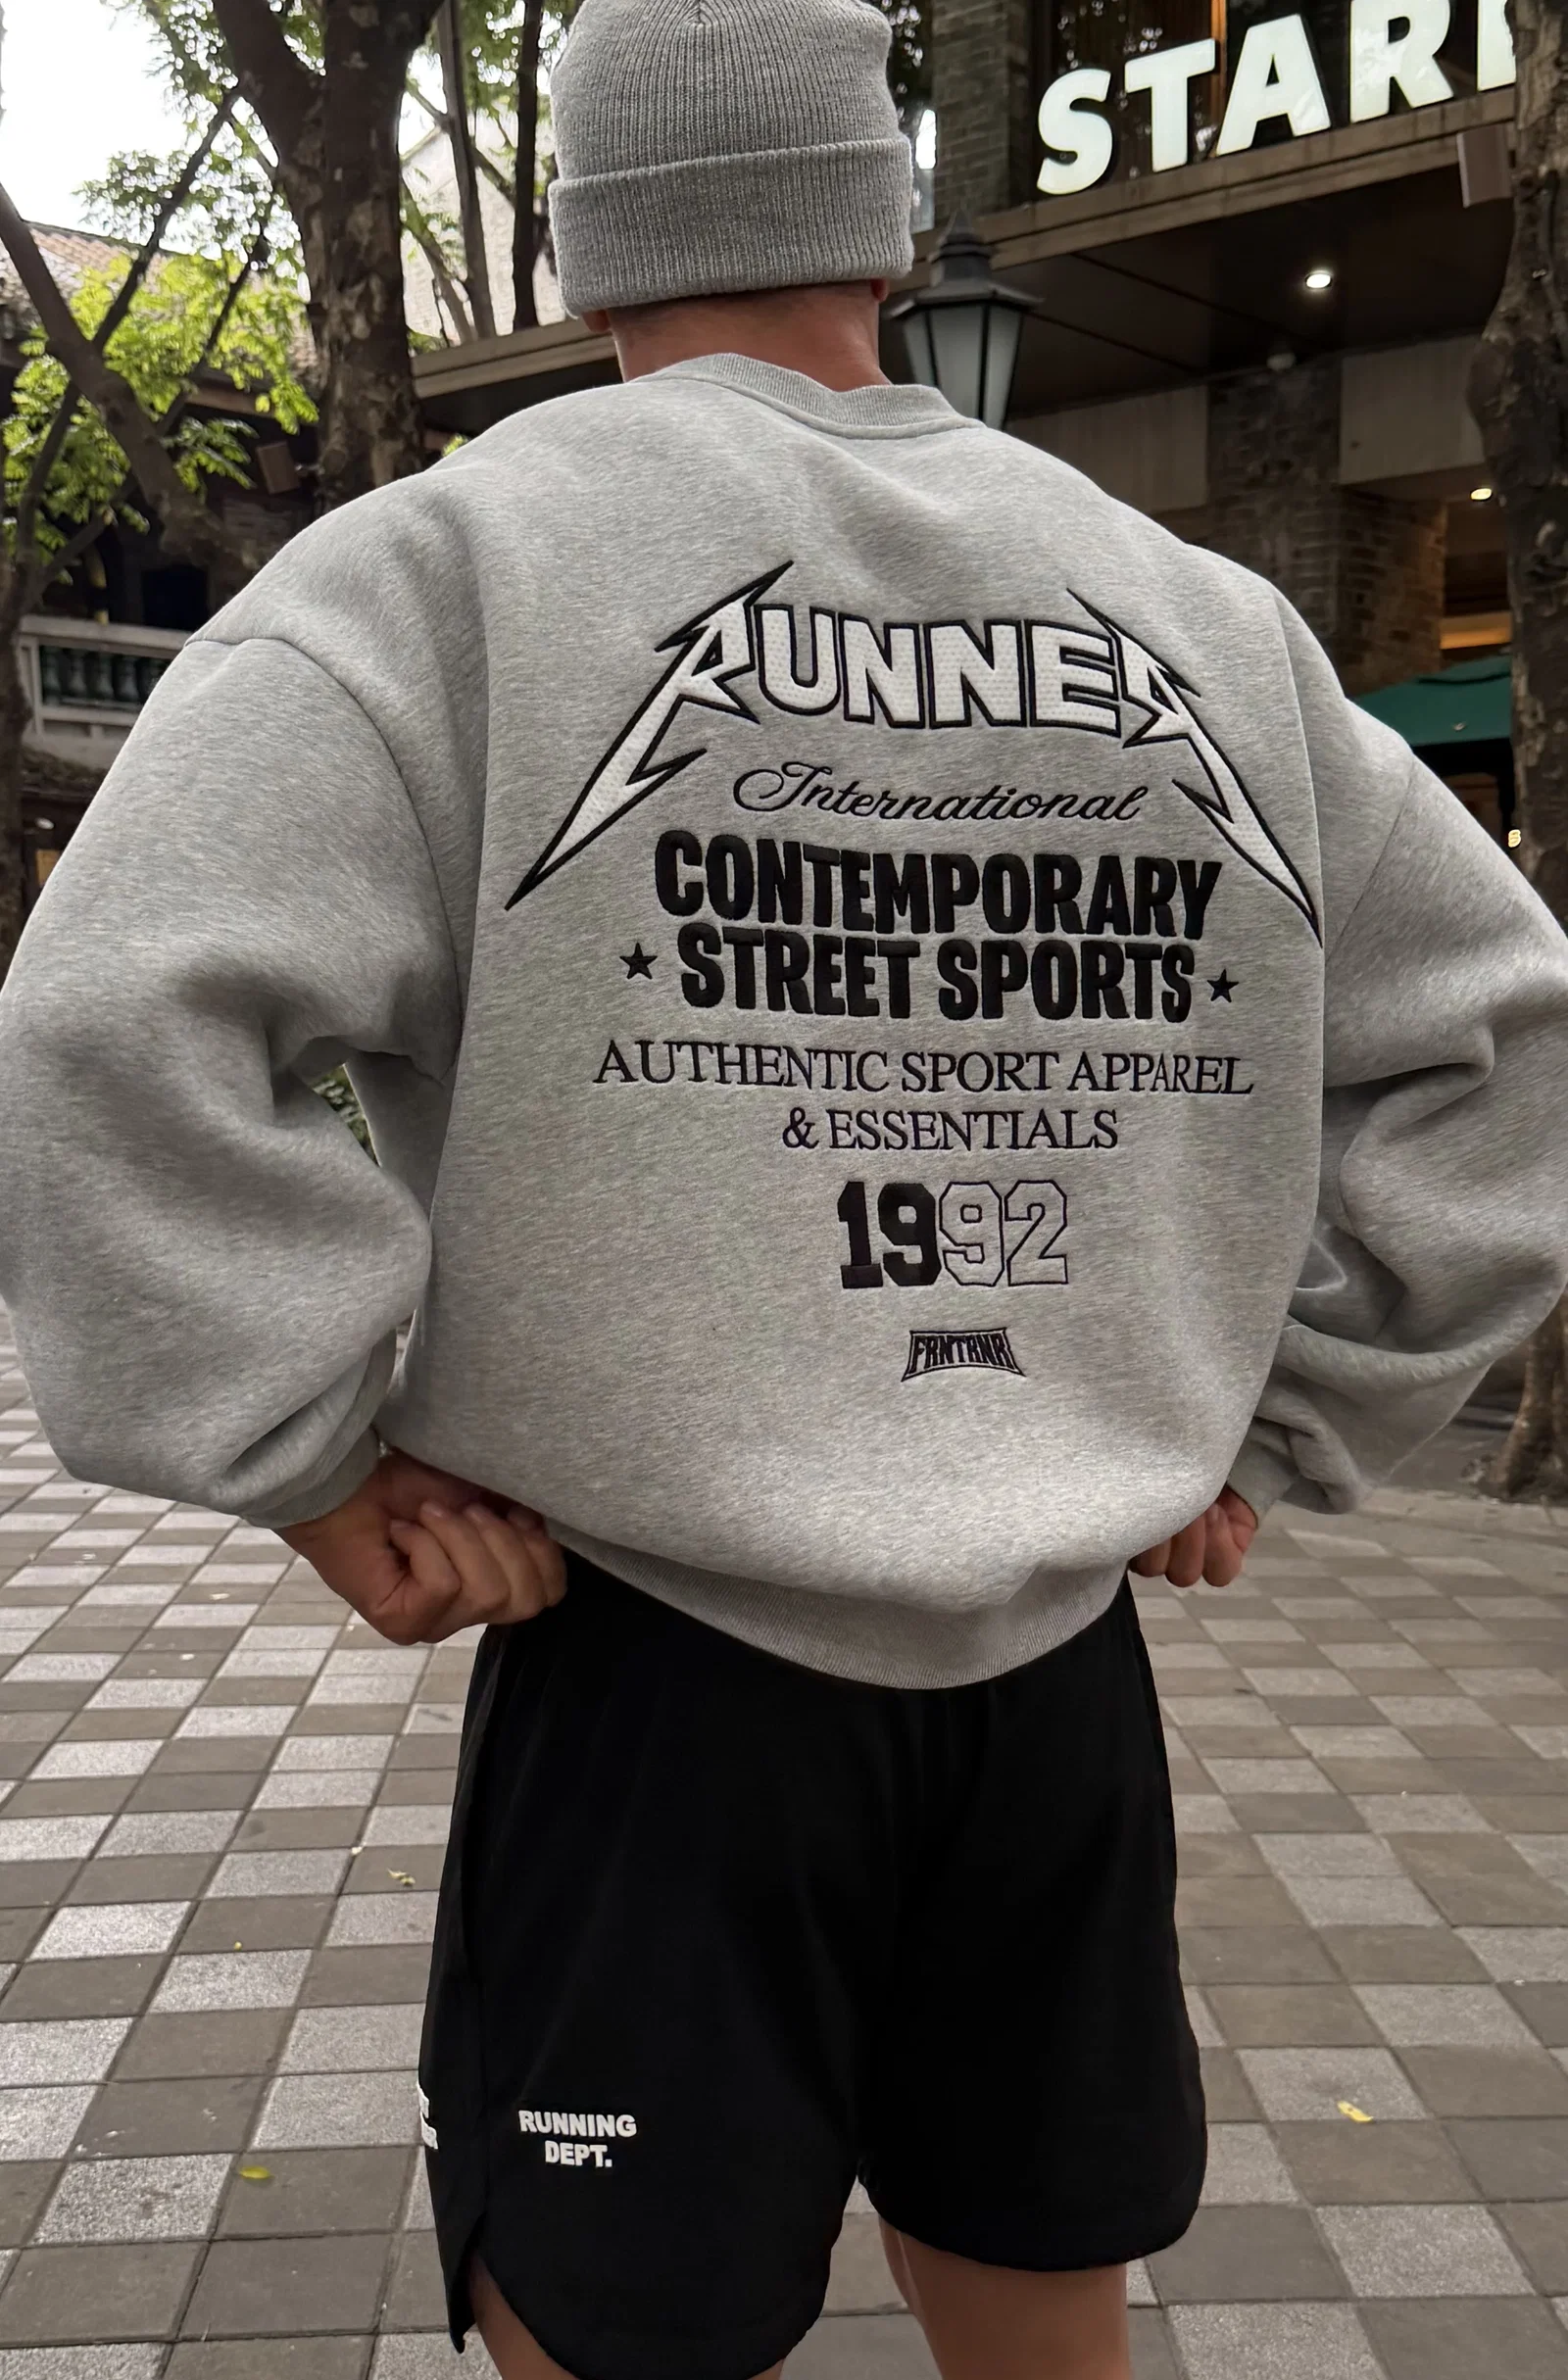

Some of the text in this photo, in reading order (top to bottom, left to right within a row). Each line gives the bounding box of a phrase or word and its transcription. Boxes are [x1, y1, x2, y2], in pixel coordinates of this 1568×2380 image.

[506, 559, 1322, 947] RUNNER
[733, 760, 1149, 821] International
[655, 830, 1222, 940] CONTEMPORARY
[677, 922, 1195, 1023] STREET SPORTS
[593, 1040, 1254, 1095] AUTHENTIC SPORT APPAREL
[782, 1106, 1119, 1151] & ESSENTIALS
[836, 1180, 1069, 1289] 1992
[518, 2110, 637, 2138] RUNNING
[545, 2140, 612, 2167] DEPT.
